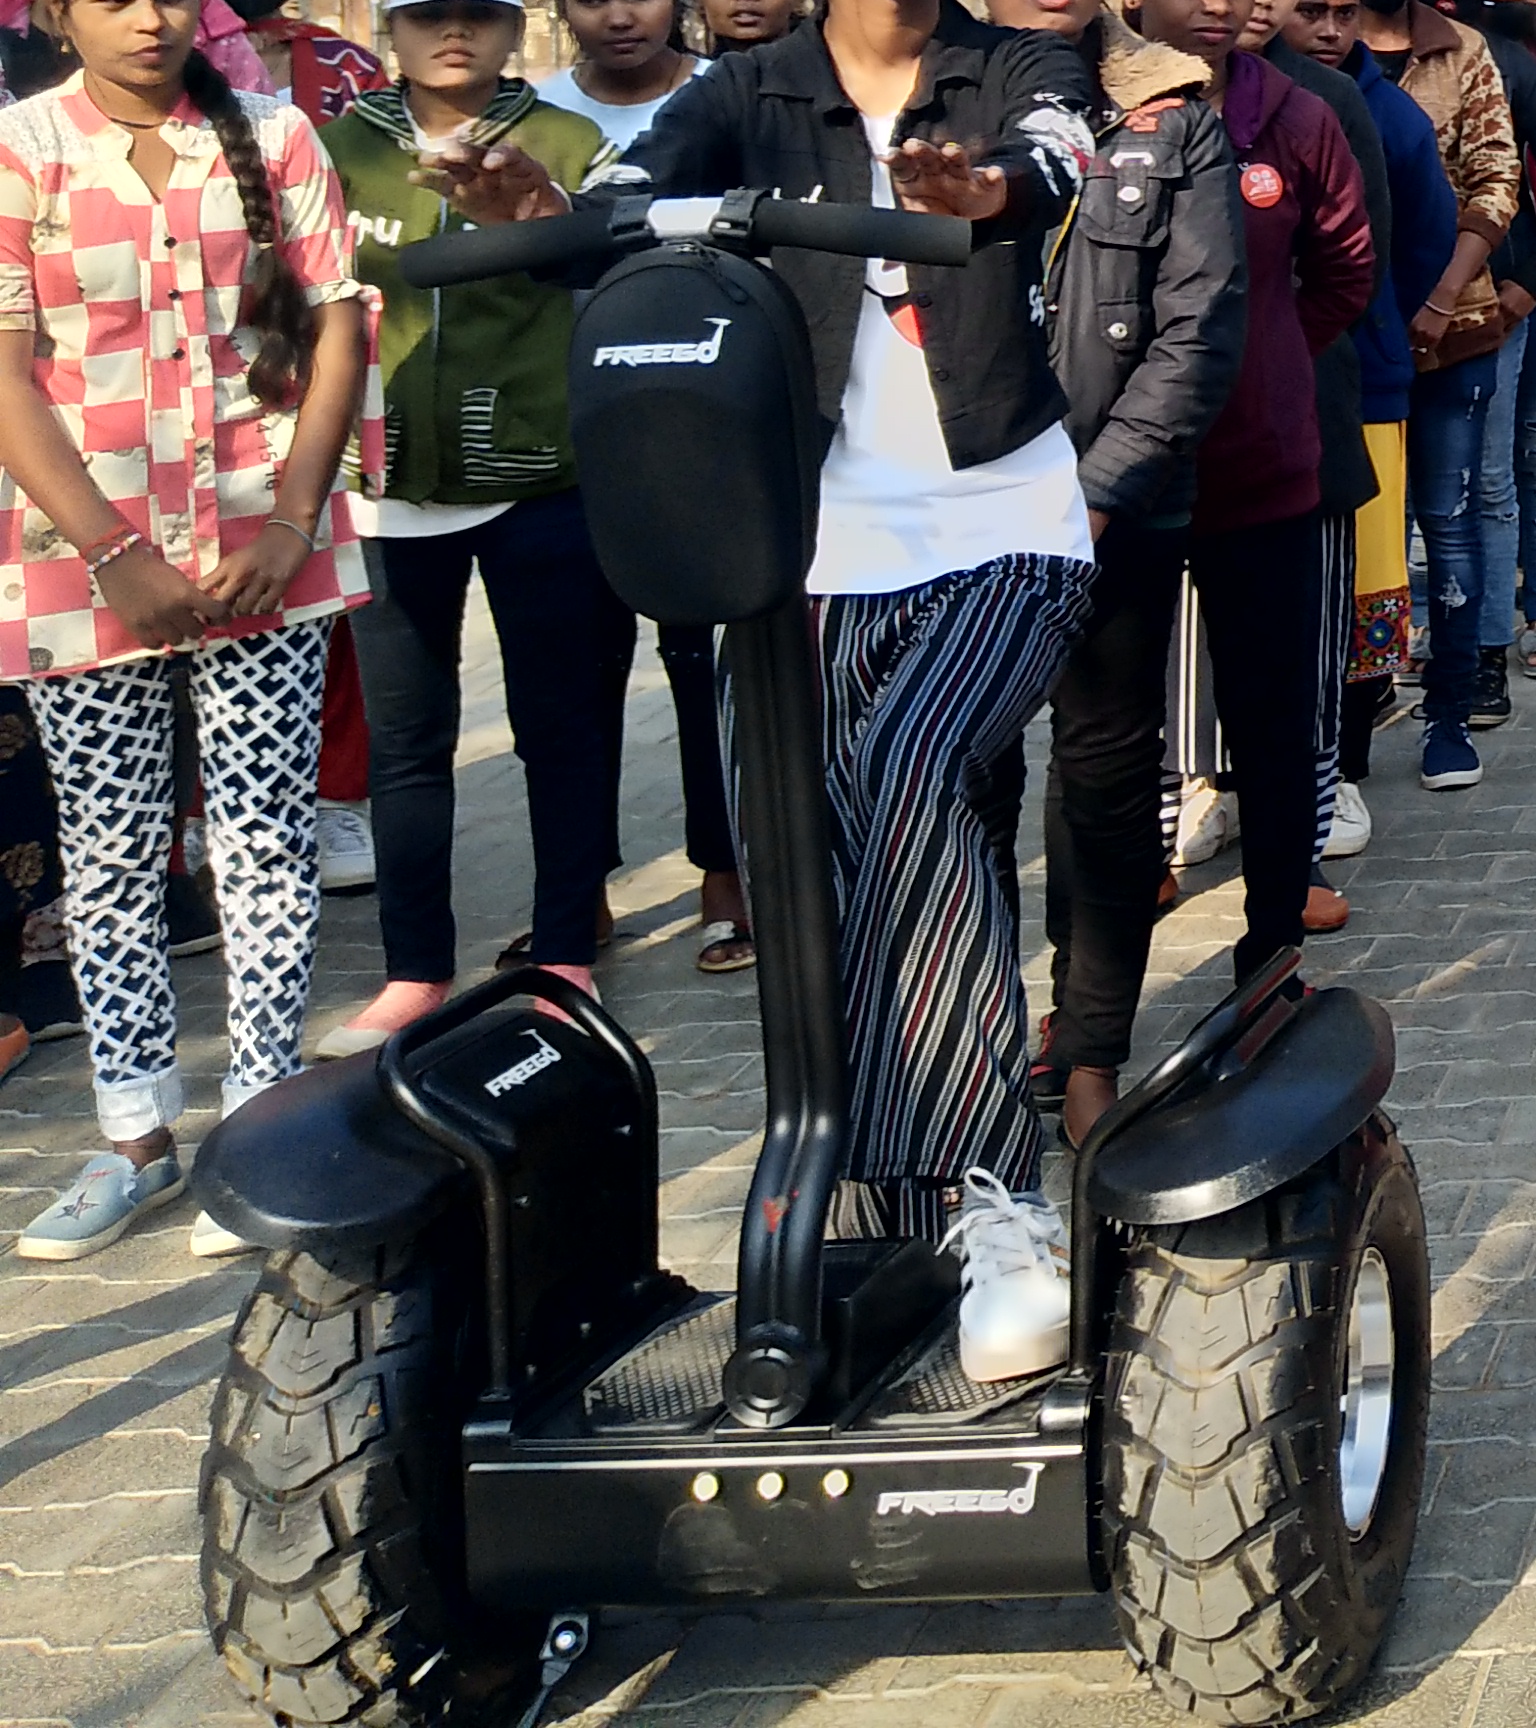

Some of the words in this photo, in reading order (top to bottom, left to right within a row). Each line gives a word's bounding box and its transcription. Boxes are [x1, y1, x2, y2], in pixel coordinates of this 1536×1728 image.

[593, 326, 726, 367] FREEGO
[484, 1035, 562, 1098] FREEGO
[877, 1473, 1040, 1516] FREEGO
